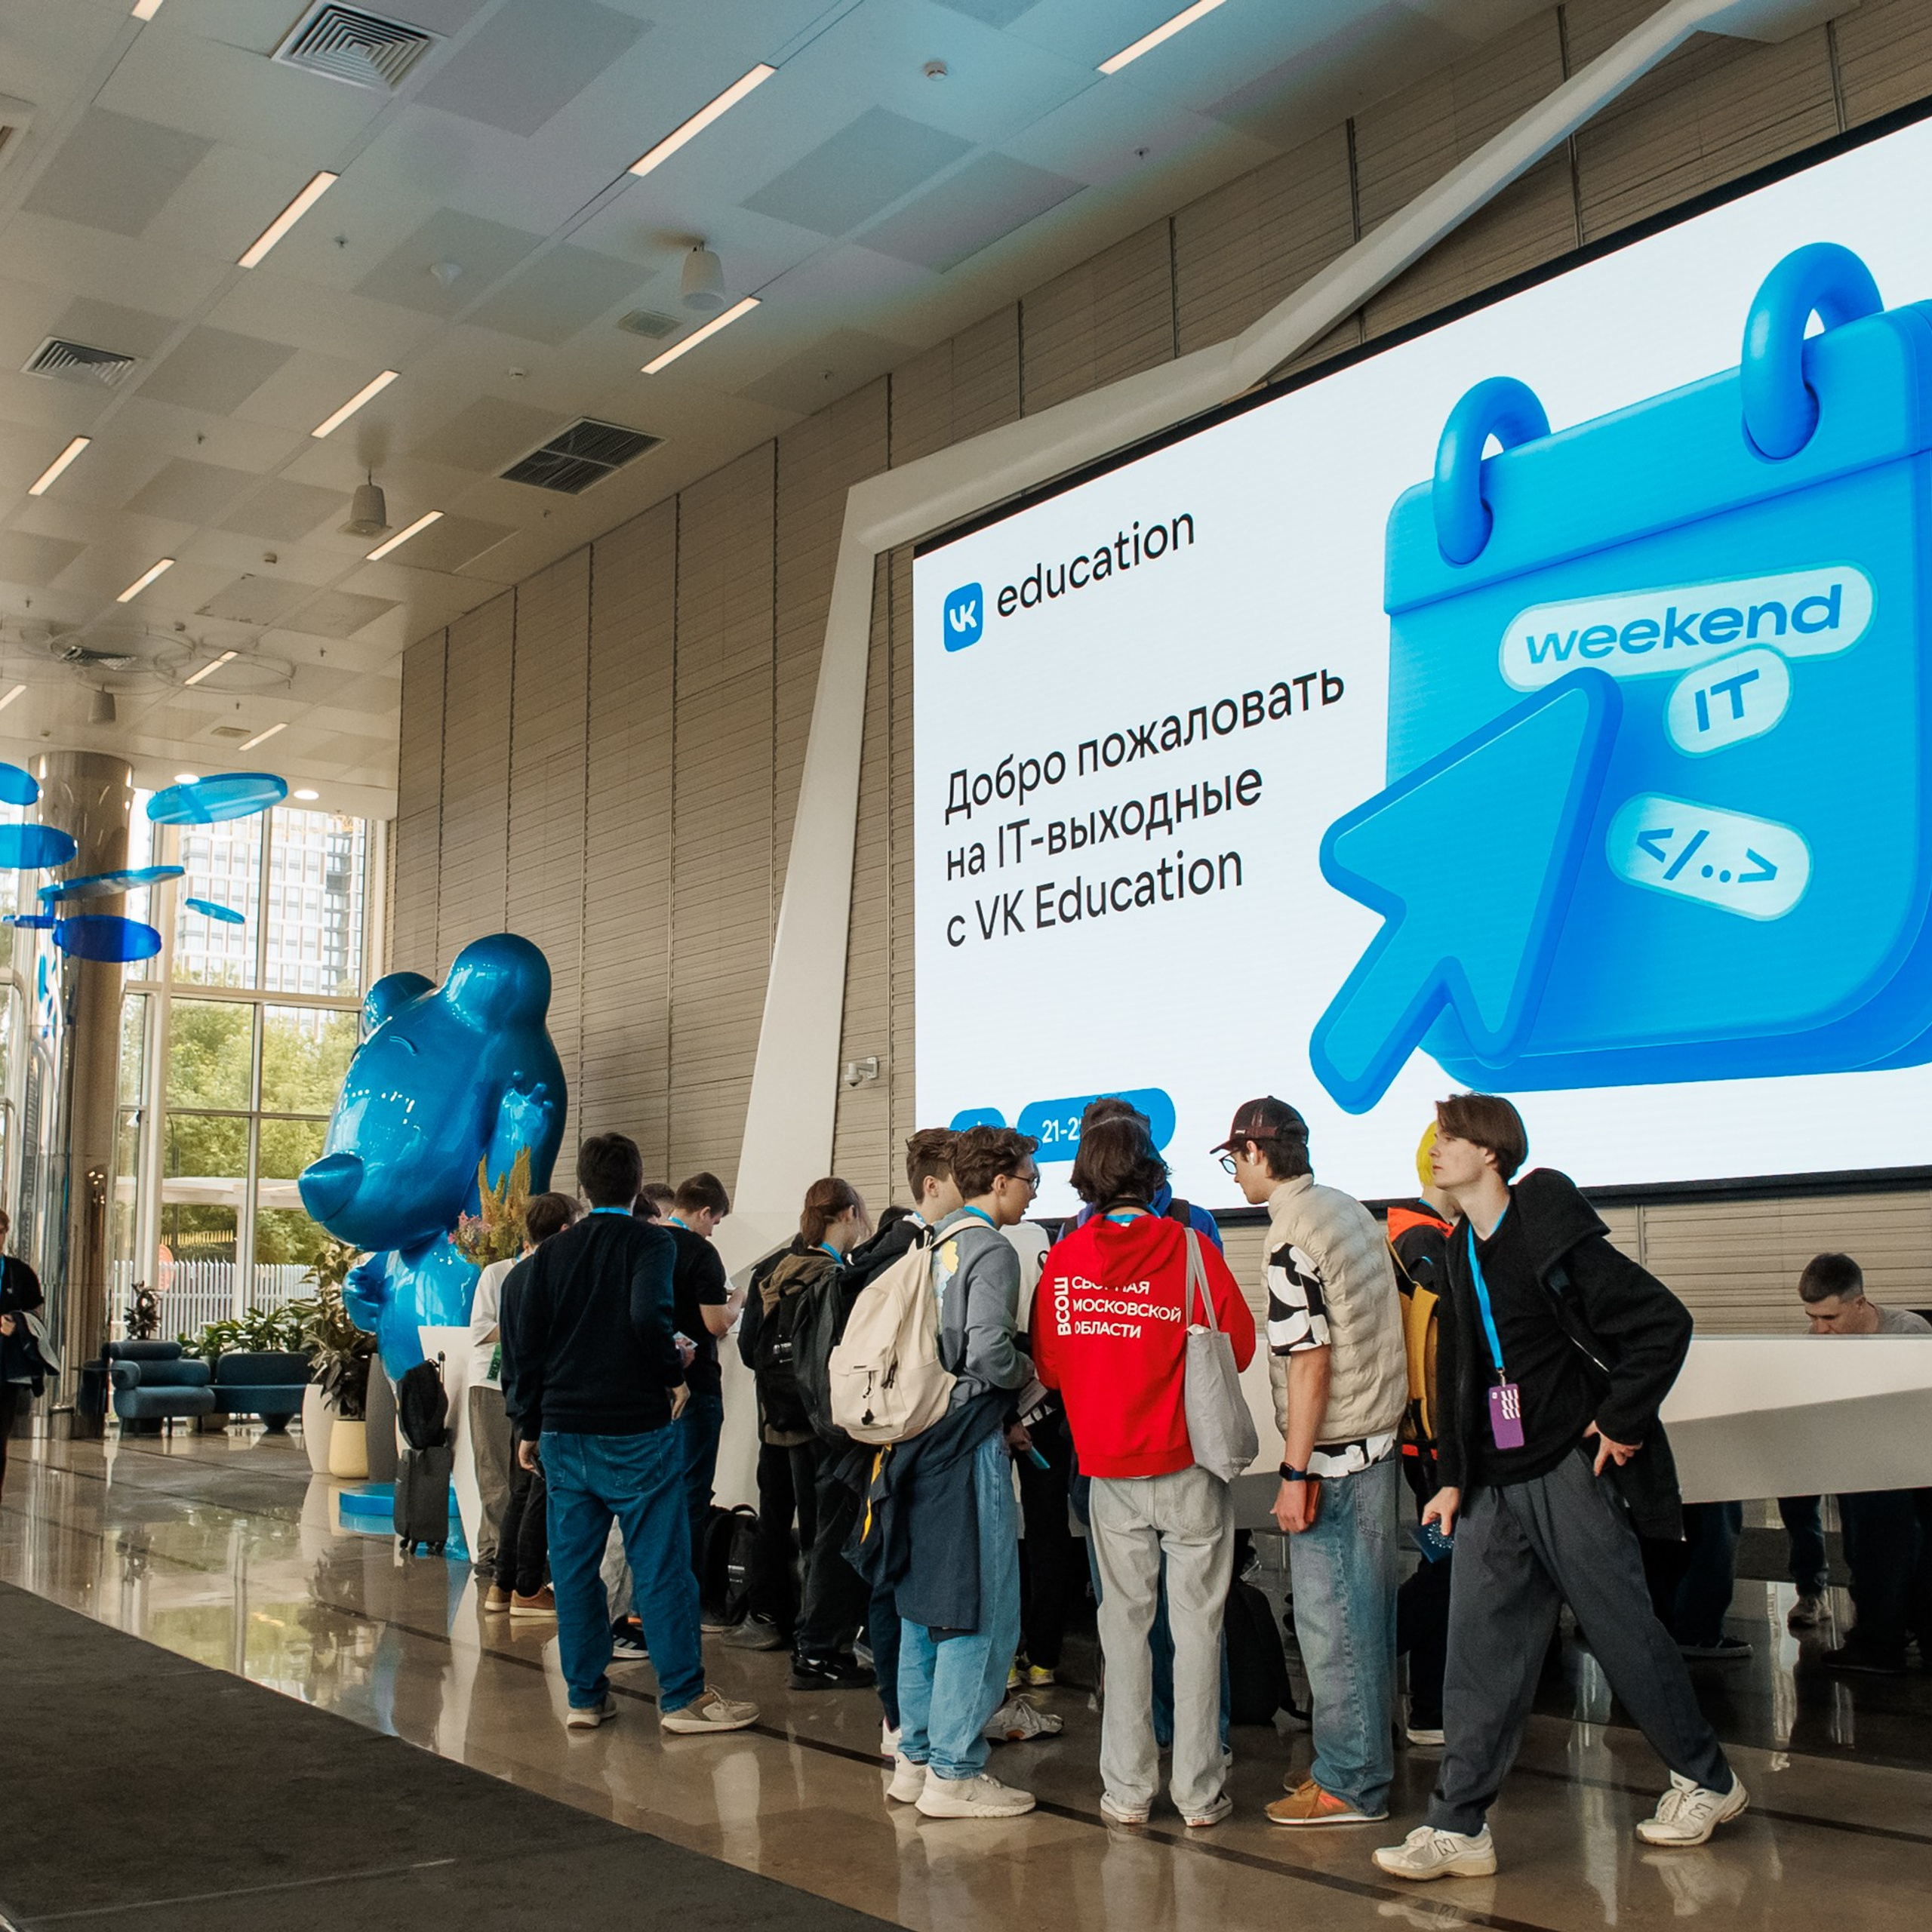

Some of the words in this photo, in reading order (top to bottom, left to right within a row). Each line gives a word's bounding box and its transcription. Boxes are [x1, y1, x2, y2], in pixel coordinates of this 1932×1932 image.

[949, 599, 978, 633] VK
[997, 513, 1195, 617] education
[1526, 583, 1843, 664] weekend
[1694, 669, 1760, 733] IT
[945, 753, 1066, 825] Добро
[1078, 668, 1345, 777] пожаловать
[946, 842, 986, 881] на
[998, 768, 1263, 869] IT-выходные
[946, 915, 966, 948] с
[975, 889, 1026, 941] VK
[1035, 848, 1243, 930] Education
[1041, 1116, 1081, 1143] 21-2
[1054, 1276, 1072, 1337] ВСОШ
[1072, 1298, 1182, 1323] МОСКОВСКОЙ
